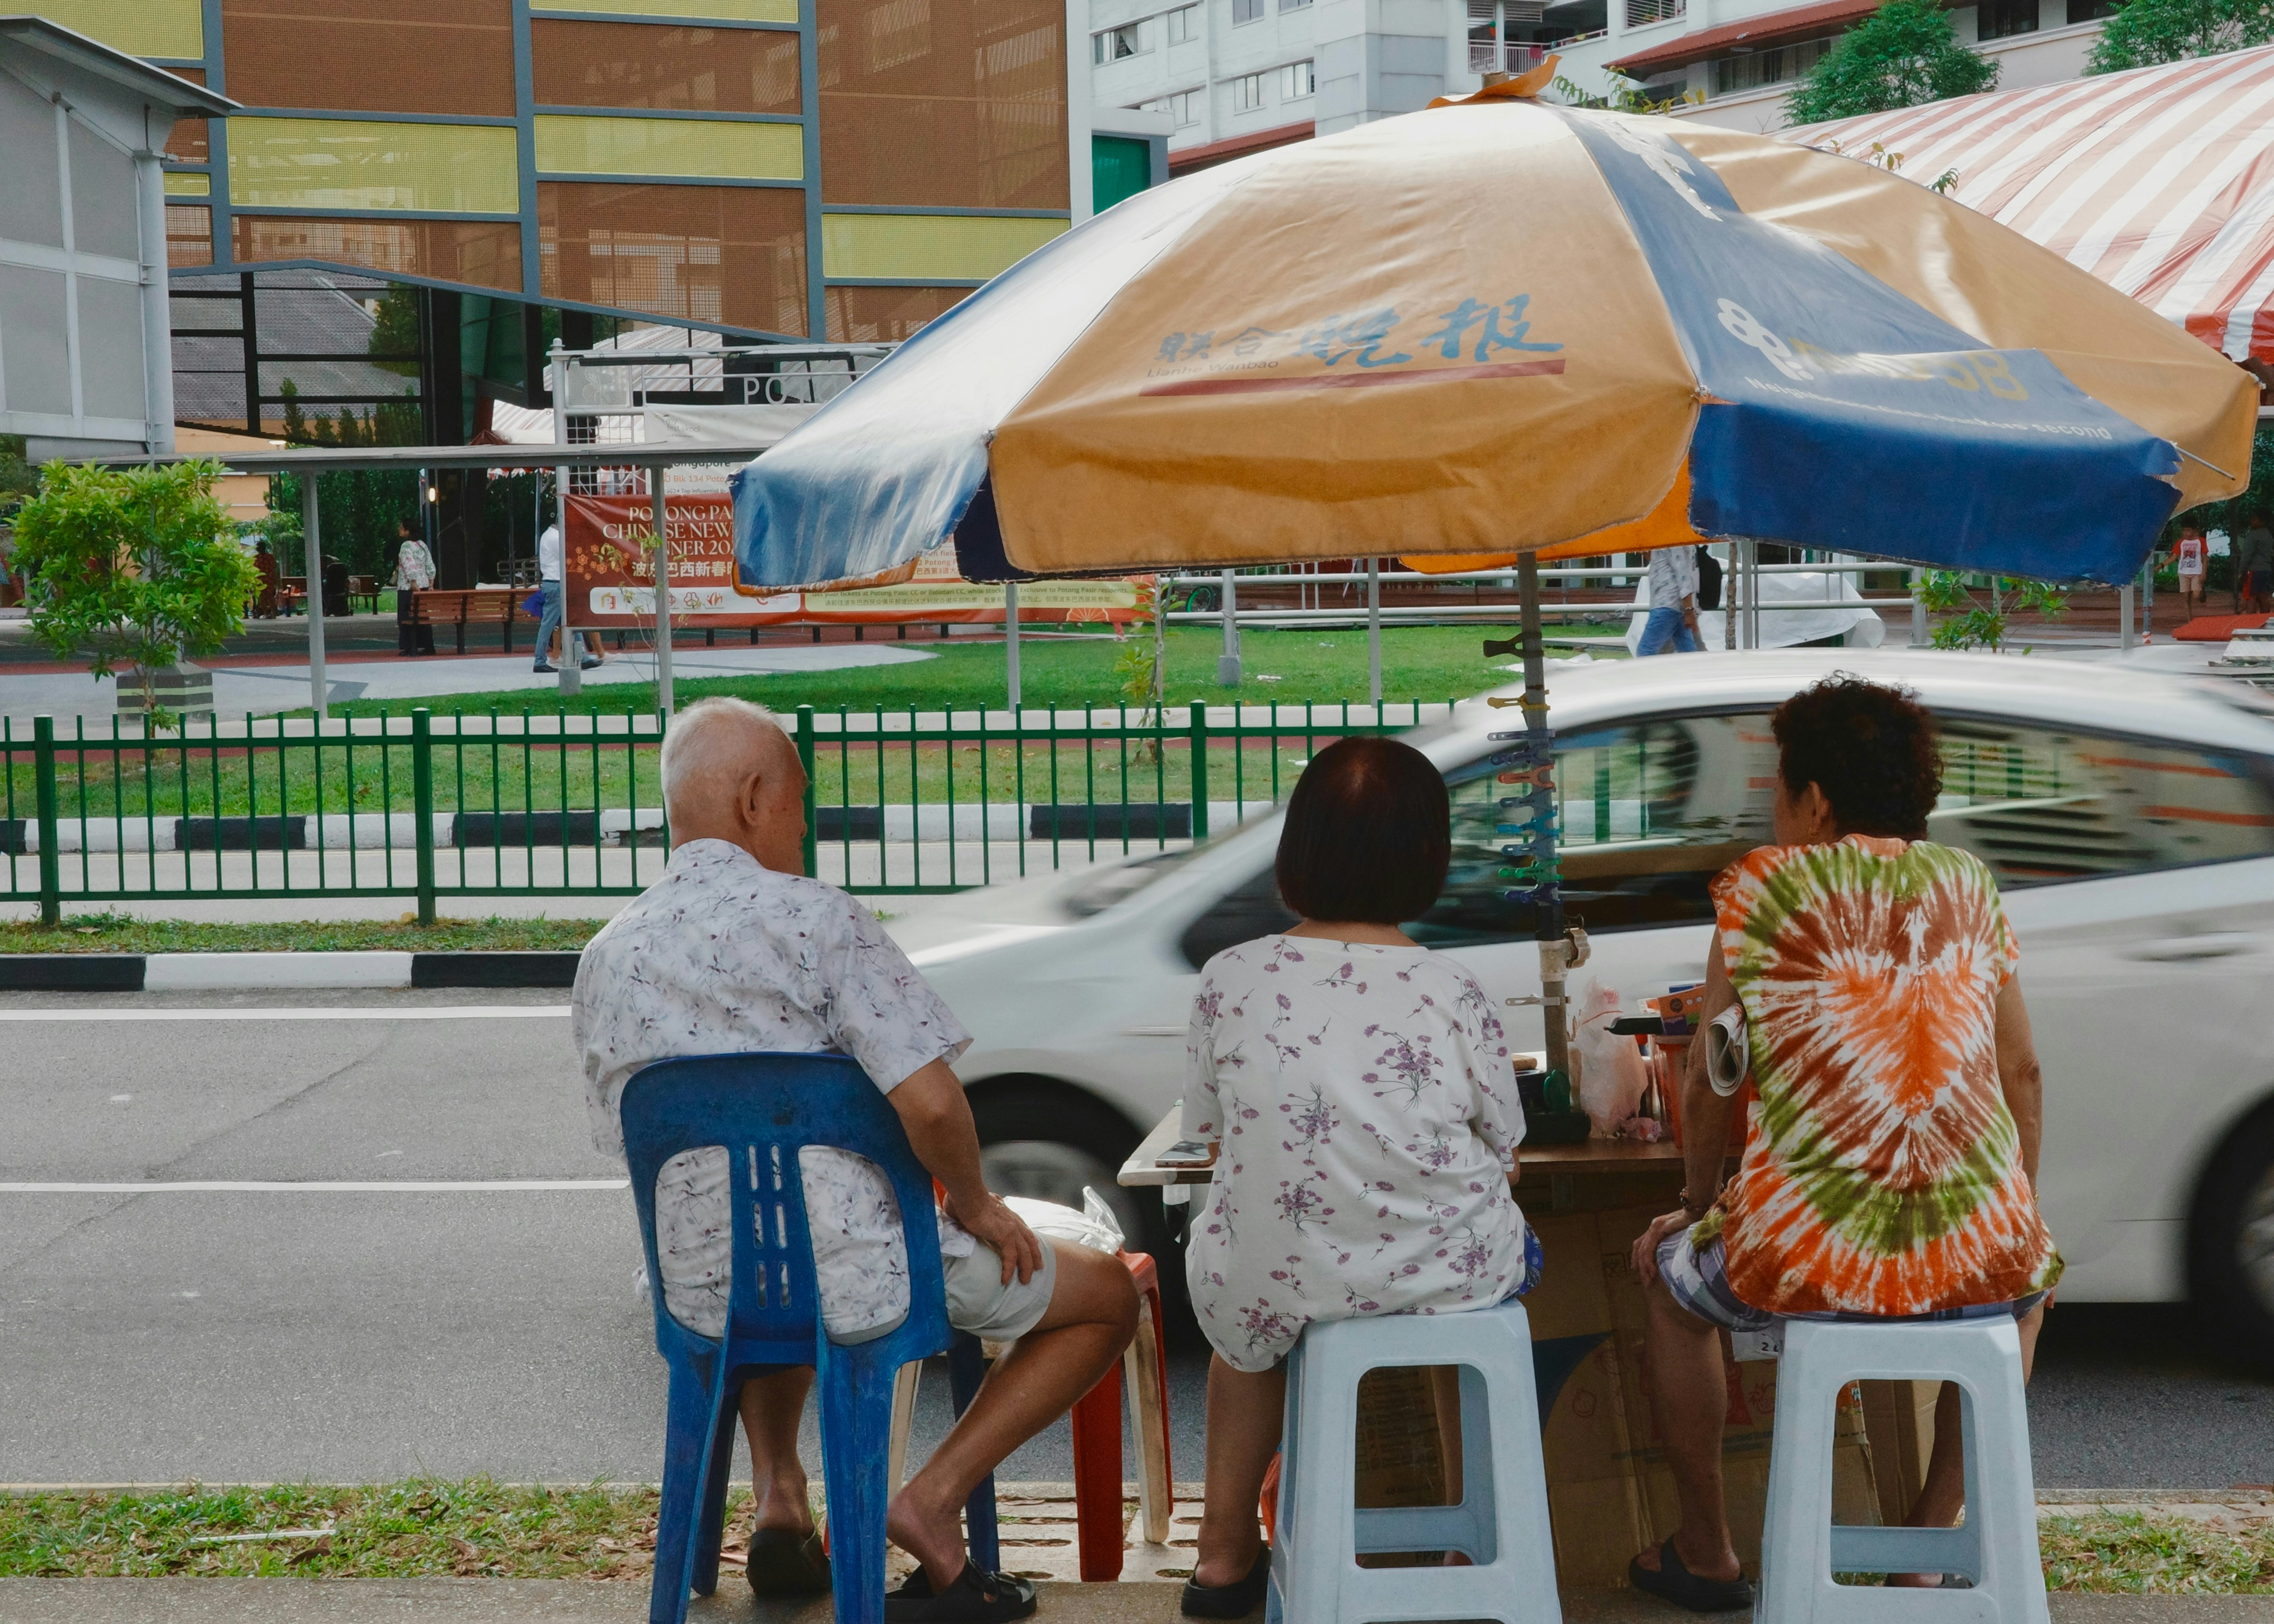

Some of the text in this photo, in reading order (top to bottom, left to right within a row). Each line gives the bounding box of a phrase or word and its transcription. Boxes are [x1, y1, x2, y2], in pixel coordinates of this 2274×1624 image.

[1147, 361, 1278, 378] Lianhe Wanbao
[2031, 424, 2112, 439] second
[629, 505, 733, 522] POONG PA
[603, 522, 733, 539] CHINSE NEW
[709, 540, 733, 555] 20
